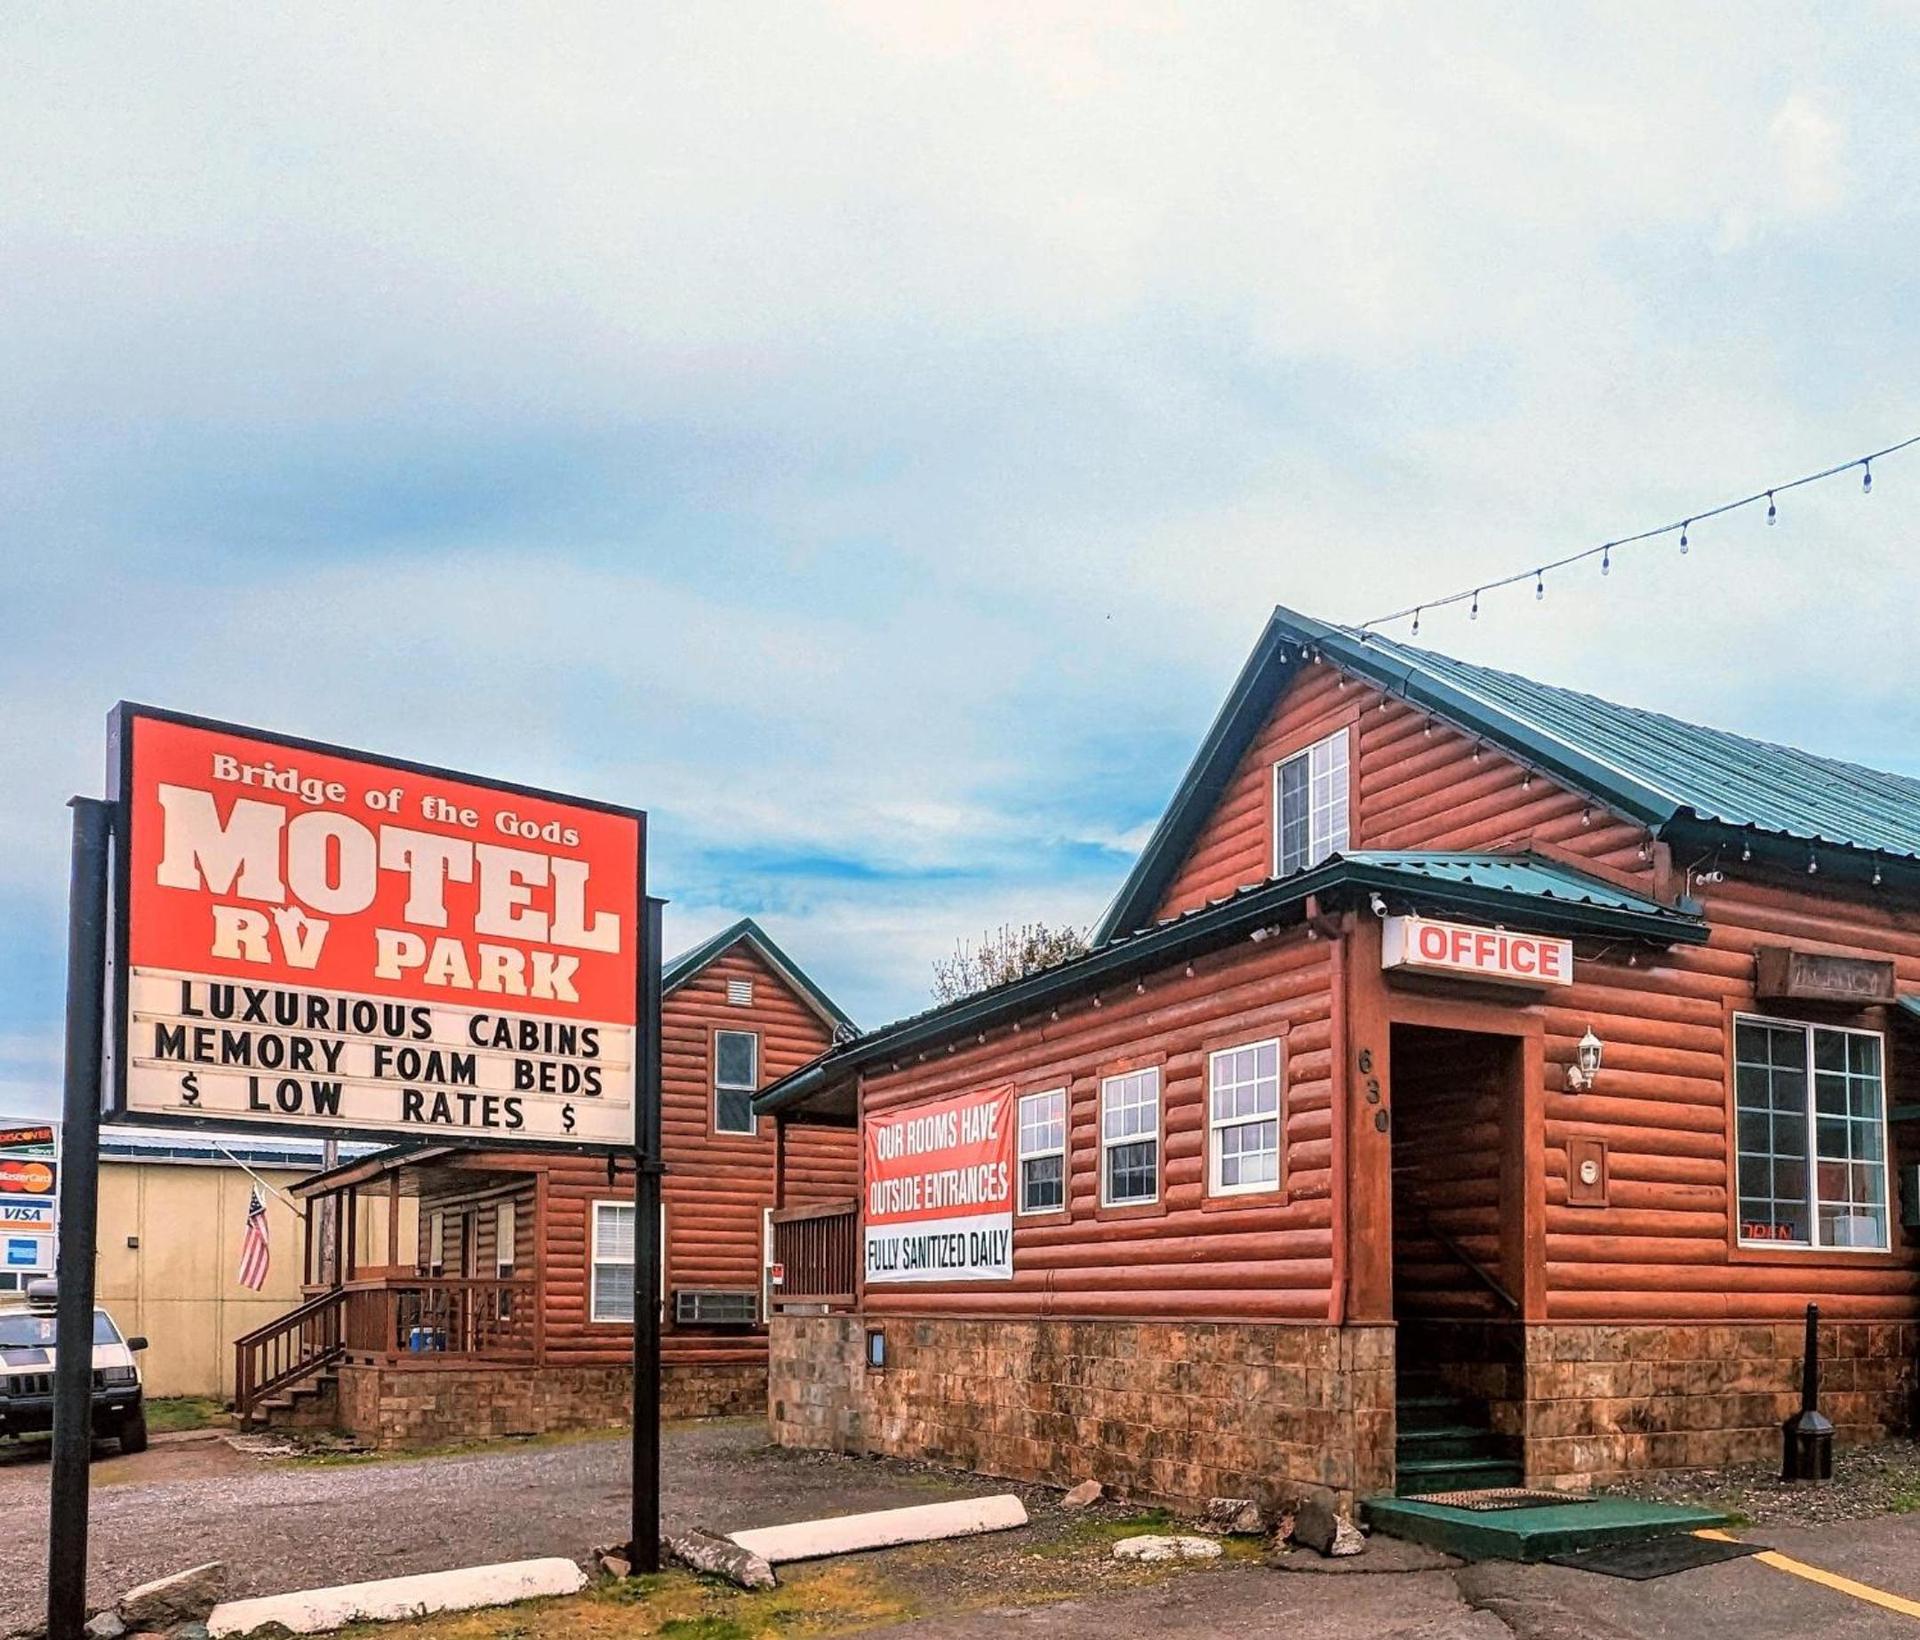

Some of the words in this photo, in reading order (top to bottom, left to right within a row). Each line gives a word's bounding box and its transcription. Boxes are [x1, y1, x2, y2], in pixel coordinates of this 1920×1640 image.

[212, 753, 347, 805] Bridge
[364, 788, 404, 813] of
[420, 795, 480, 828] the
[494, 811, 581, 847] Gods
[156, 782, 620, 954] MOTEL
[211, 903, 330, 970] RV
[374, 927, 580, 1003] PARK
[1419, 926, 1560, 977] OFFICE
[182, 980, 433, 1041] LUXURIOUS
[469, 1014, 600, 1059] CABINS
[155, 1023, 345, 1073] MEMORY
[374, 1044, 477, 1086] FOAM
[514, 1058, 603, 1097] BEDS
[1359, 1048, 1389, 1133] 630
[181, 1071, 200, 1105] $
[249, 1076, 342, 1116] LOW
[402, 1088, 524, 1129] RATES
[561, 1103, 576, 1133] $
[877, 1122, 905, 1162] OUR
[907, 1110, 958, 1154] ROOMS
[961, 1101, 999, 1144] HAVE
[4, 1207, 41, 1221] VISA
[870, 1175, 922, 1217] OUTSIDE
[925, 1161, 1009, 1209] ENTRANCES
[868, 1238, 899, 1272] FULLY
[903, 1233, 965, 1270] SANITIZED
[971, 1229, 1009, 1267] DAILY
